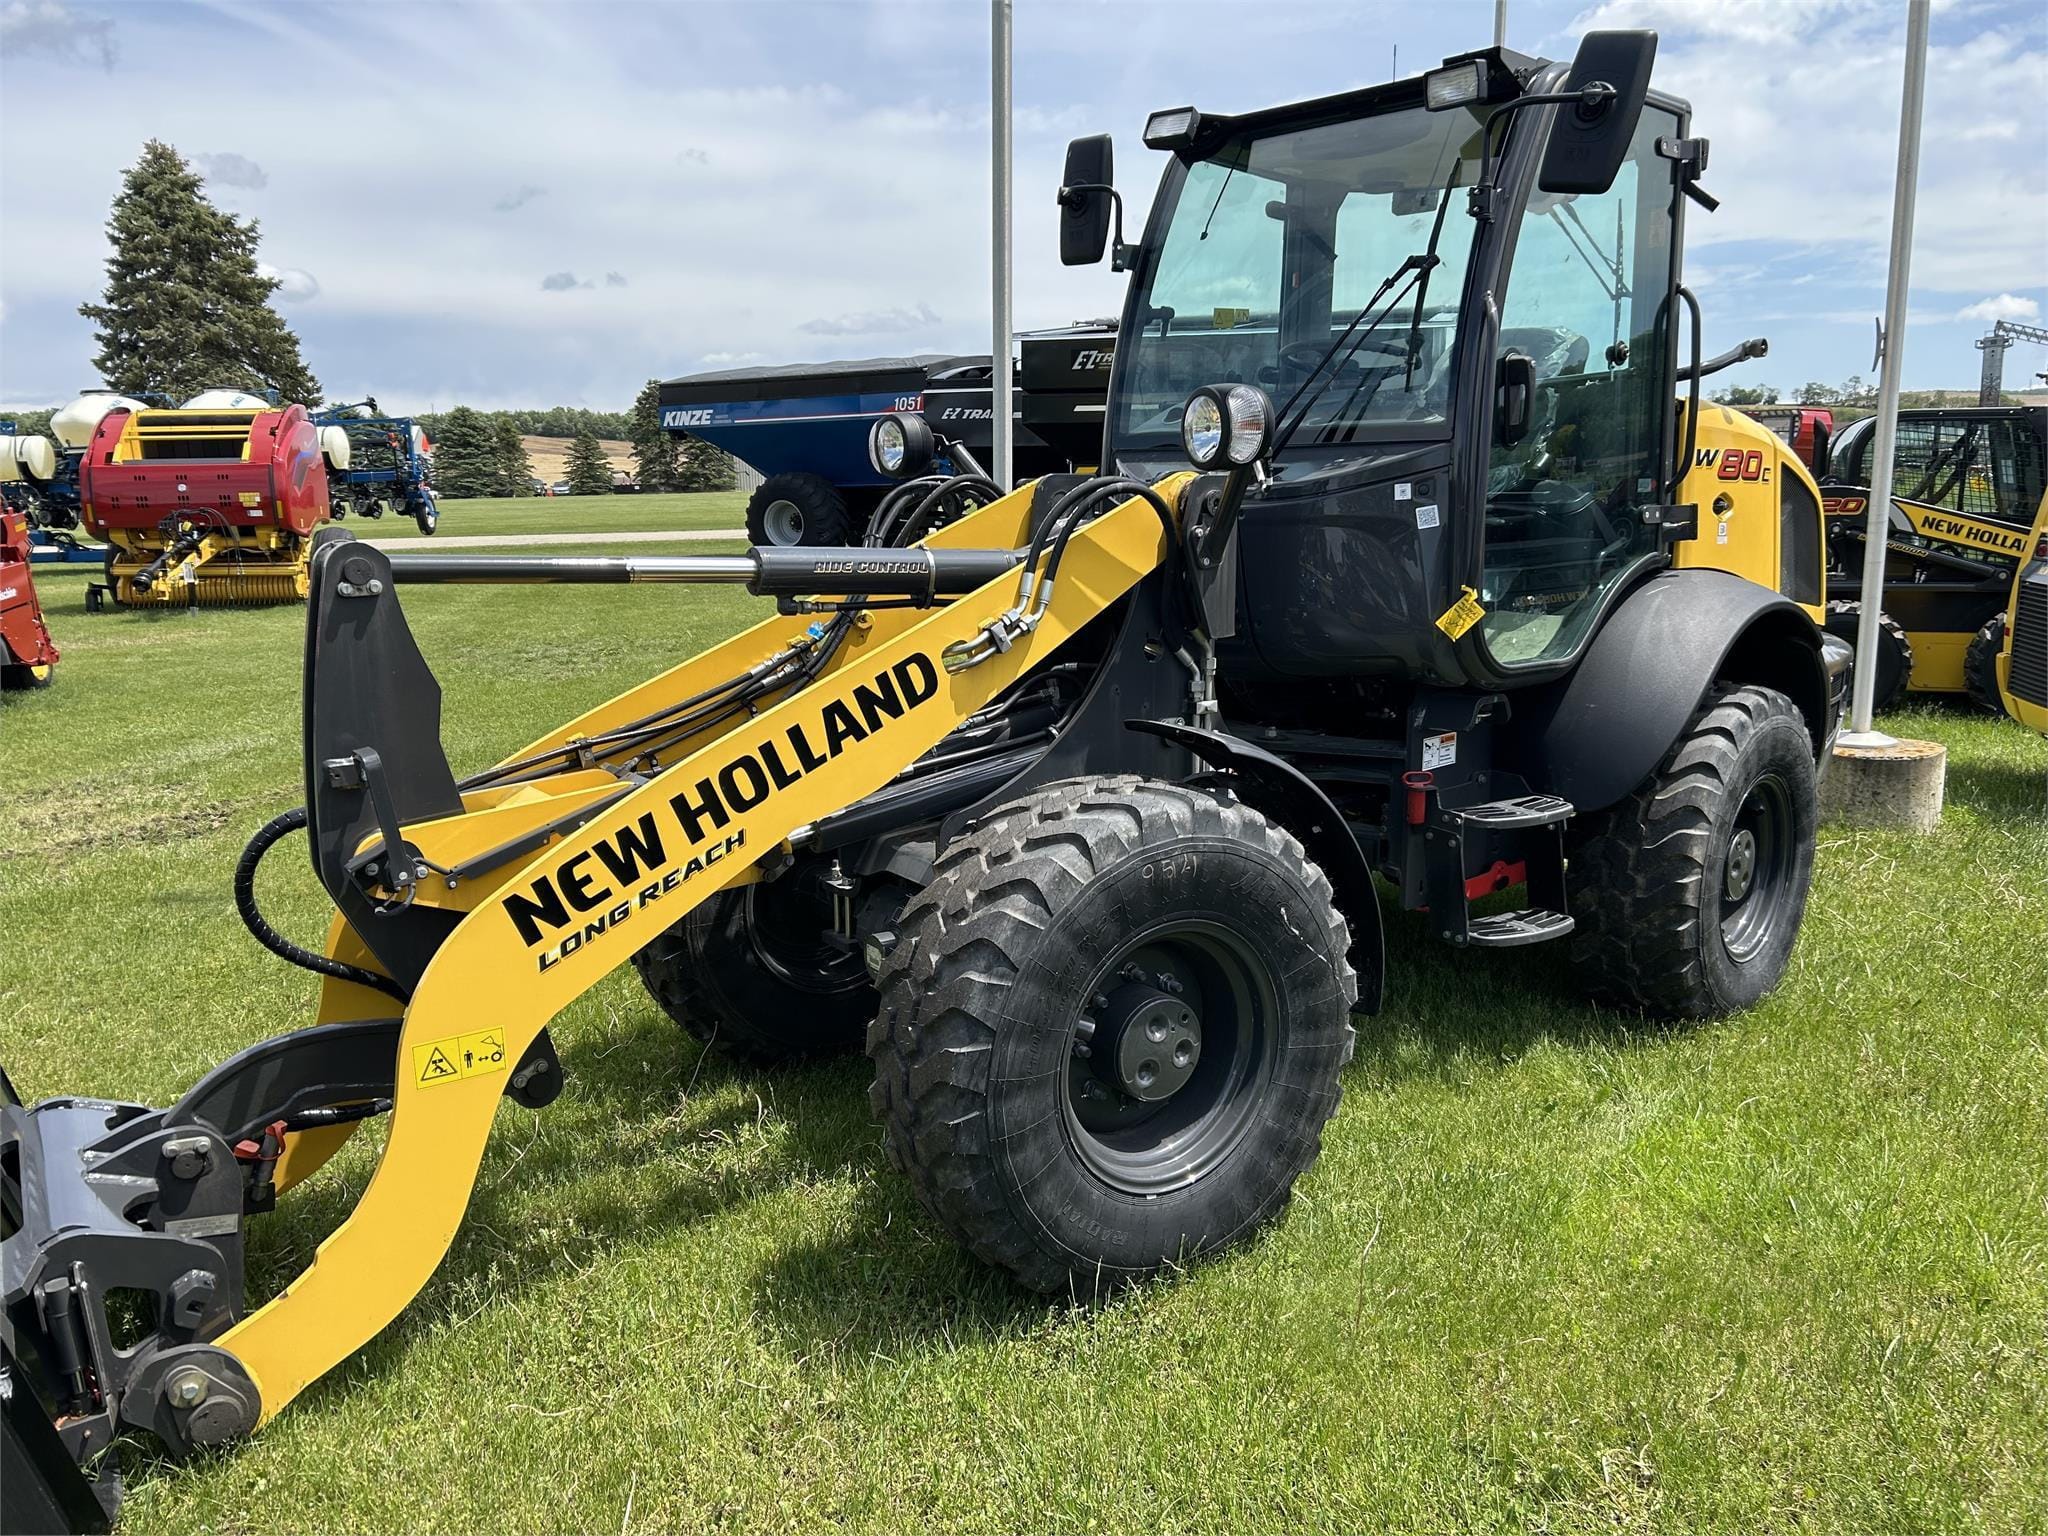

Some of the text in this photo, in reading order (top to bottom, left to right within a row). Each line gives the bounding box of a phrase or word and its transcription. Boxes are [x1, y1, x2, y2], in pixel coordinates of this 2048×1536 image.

[894, 396, 921, 411] 1051
[663, 409, 713, 427] KINZE
[1921, 515, 1964, 537] NEW
[814, 561, 929, 574] RIDE CONTROL
[501, 652, 940, 948] NEW HOLLAND
[537, 828, 747, 974] LONG REACH
